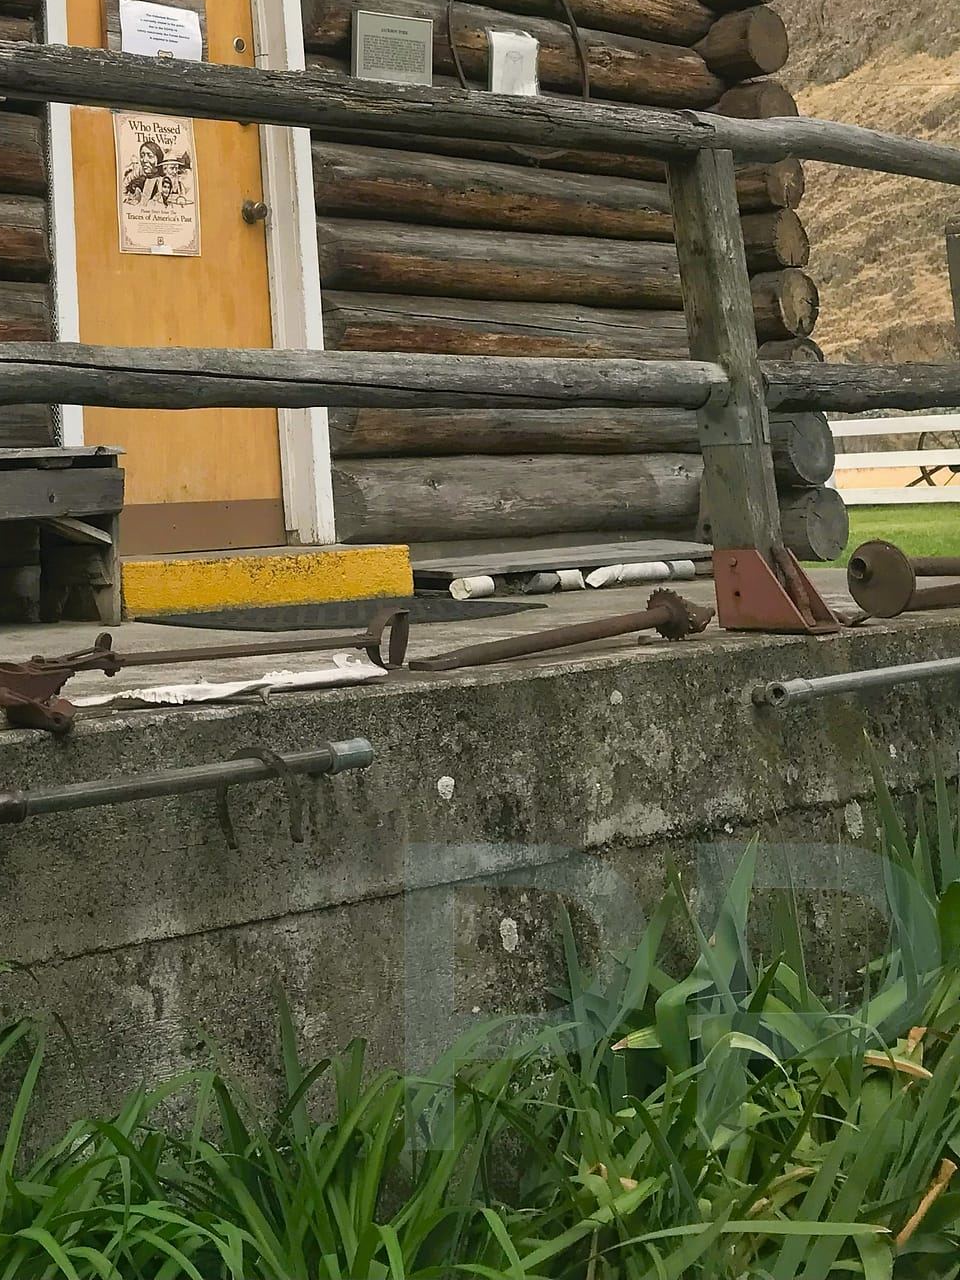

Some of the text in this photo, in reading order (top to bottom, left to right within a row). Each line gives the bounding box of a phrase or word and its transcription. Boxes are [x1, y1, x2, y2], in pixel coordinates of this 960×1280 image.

[128, 120, 181, 135] Who Passed
[134, 132, 177, 146] This Way?
[126, 212, 144, 220] Traces
[180, 215, 192, 223] Past
